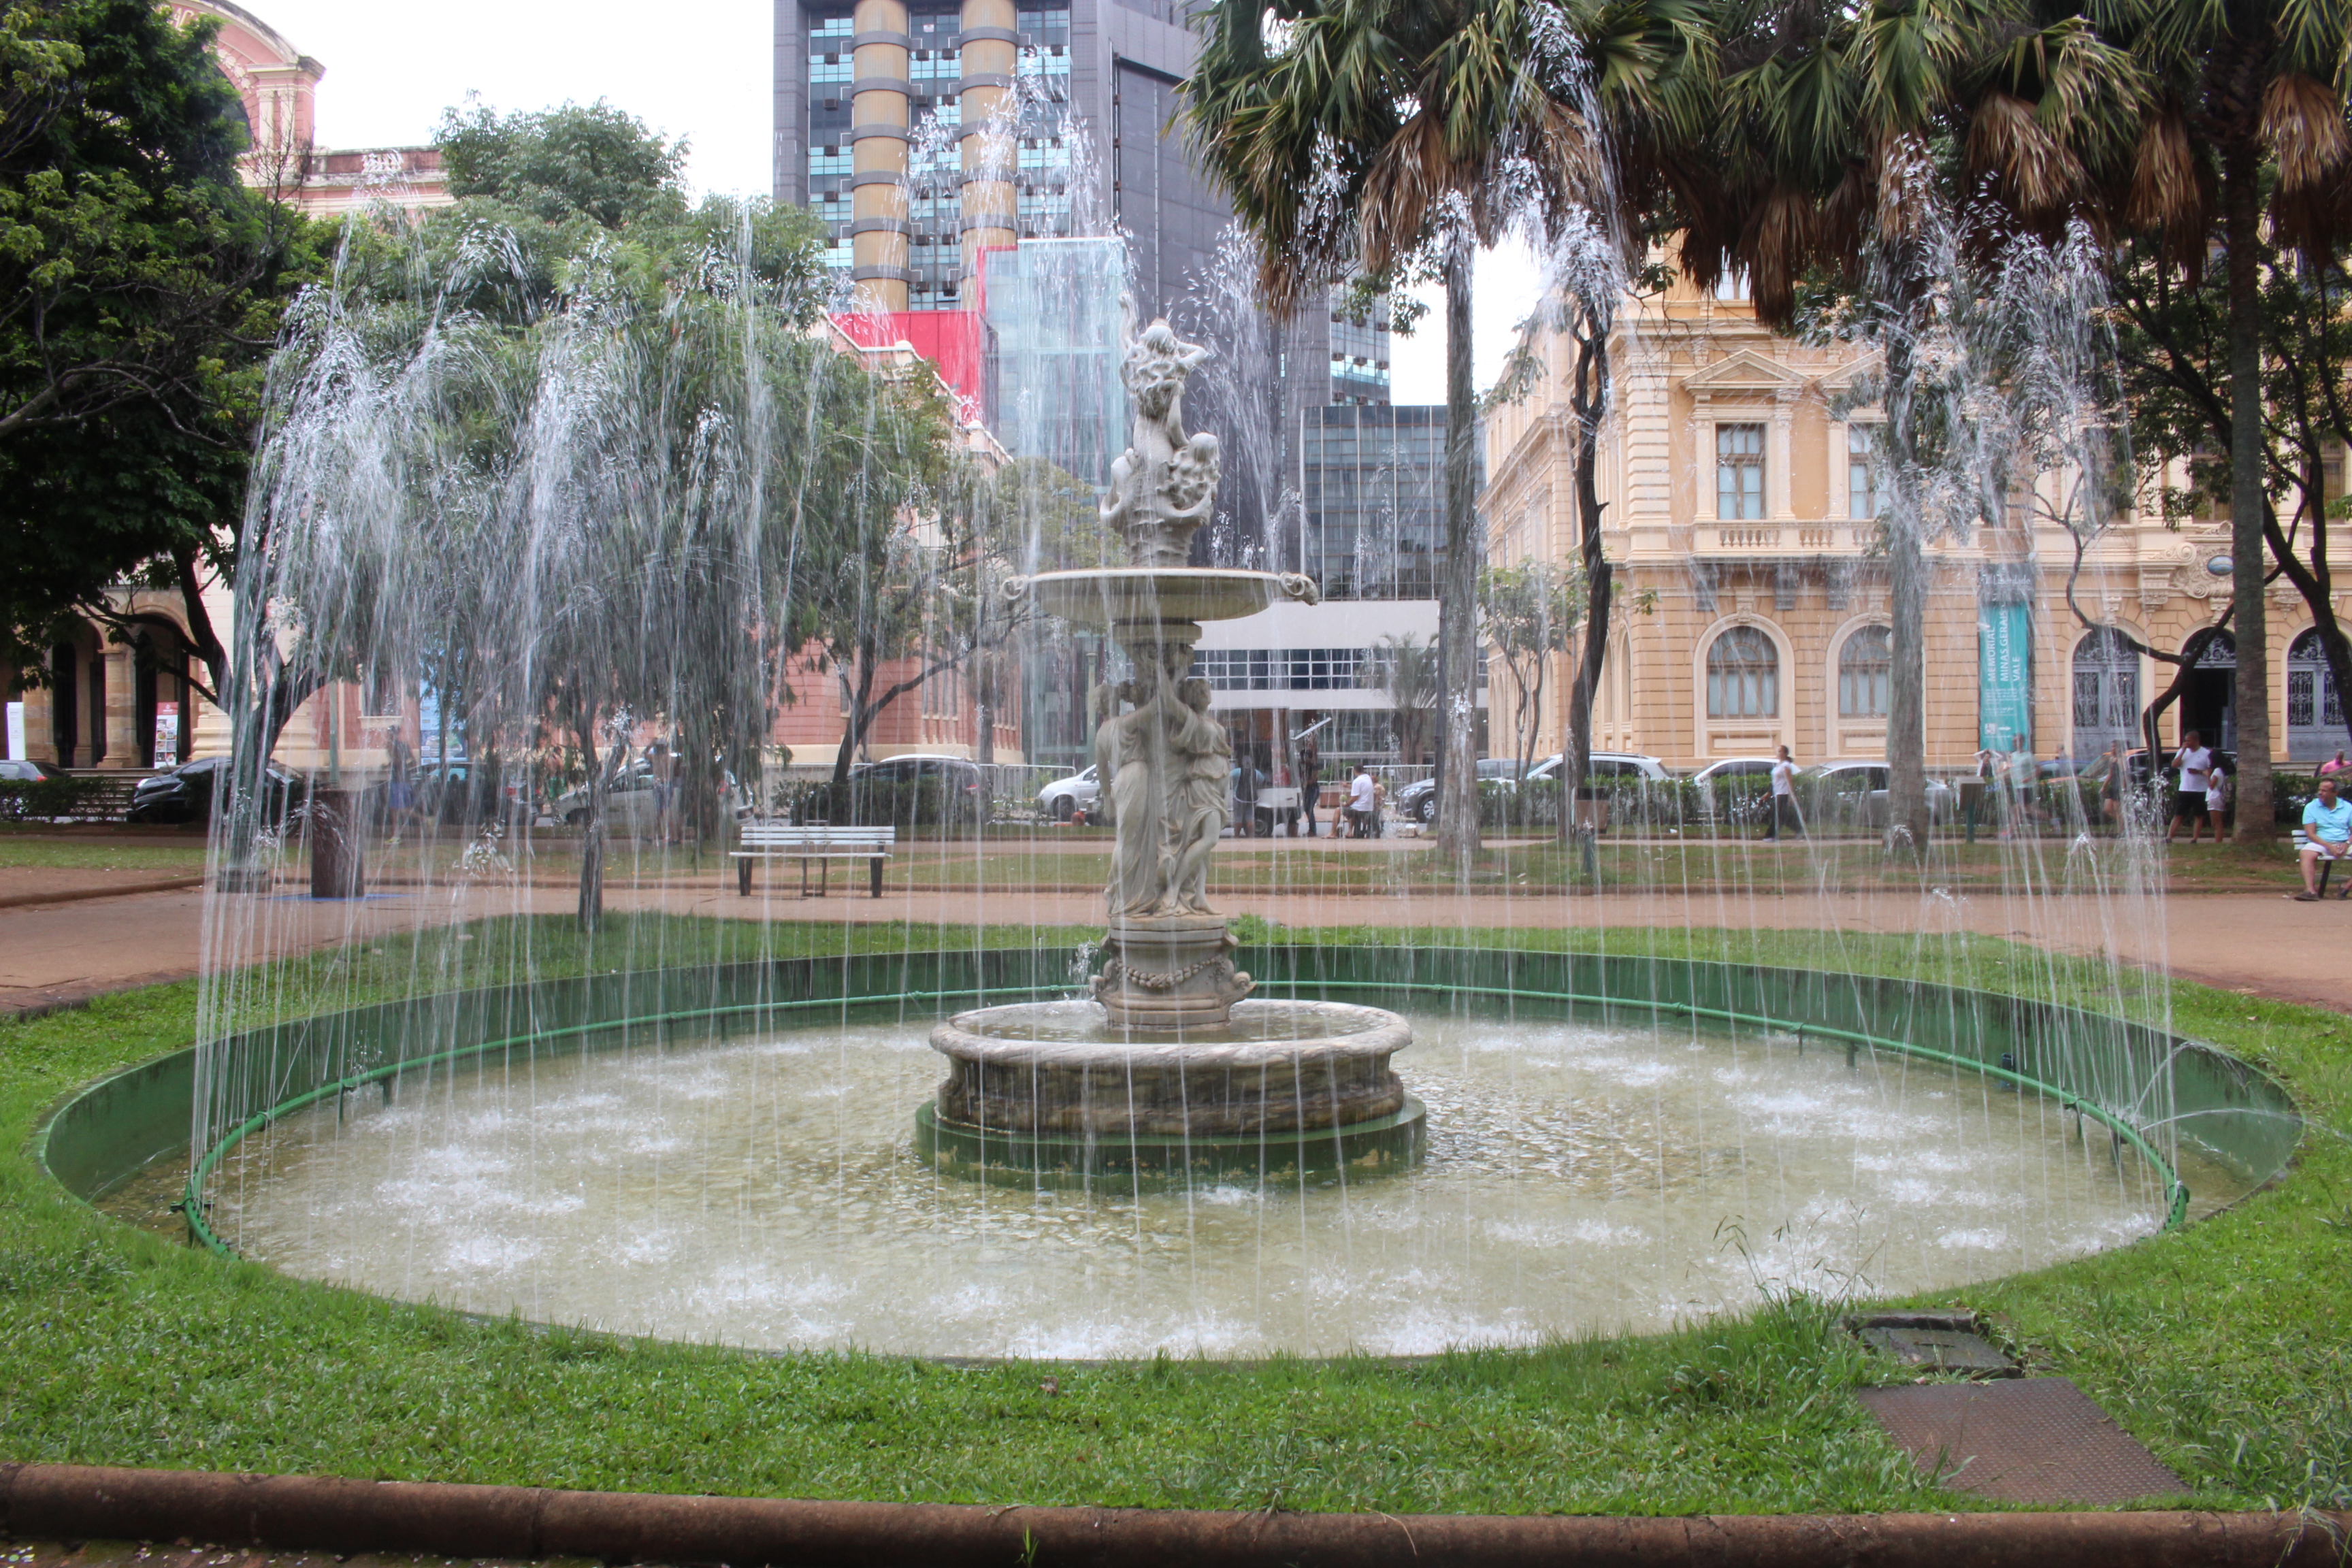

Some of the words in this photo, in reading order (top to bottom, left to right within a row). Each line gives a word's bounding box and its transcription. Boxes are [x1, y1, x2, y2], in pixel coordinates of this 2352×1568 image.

[1999, 610, 2008, 646] GERAIS
[1987, 627, 1995, 681] MEMORIAL
[2000, 648, 2008, 681] MINAS
[2012, 657, 2021, 681] VALE
